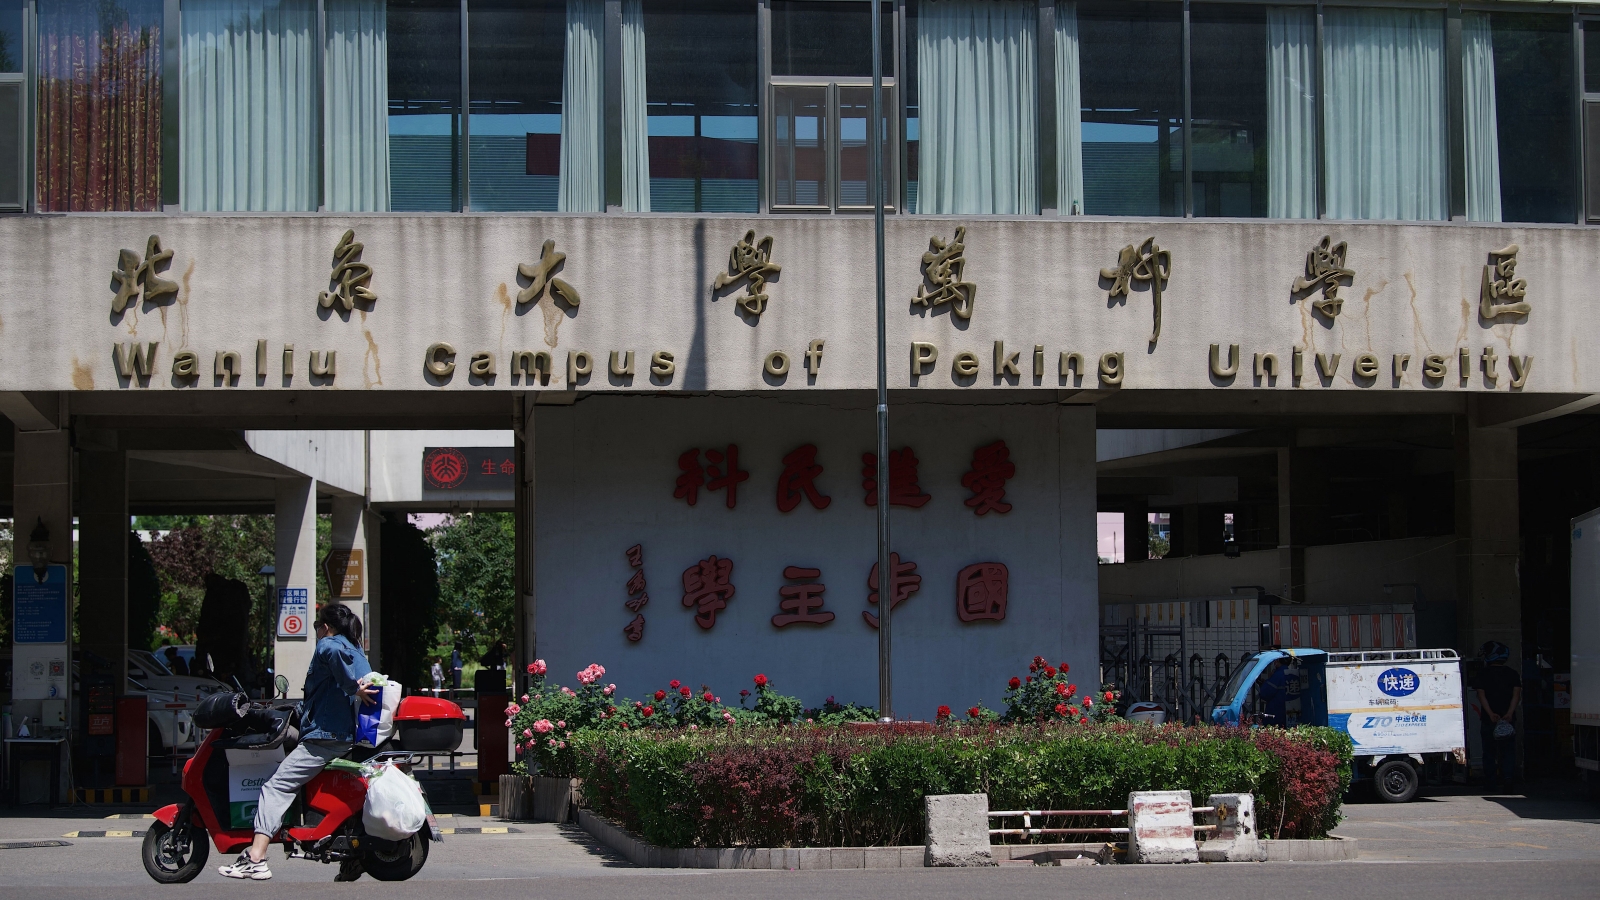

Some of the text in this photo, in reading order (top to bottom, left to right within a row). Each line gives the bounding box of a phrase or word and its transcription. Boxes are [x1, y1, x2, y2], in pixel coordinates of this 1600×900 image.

[113, 338, 1533, 387] Wanliu Campus of Peking University
[481, 458, 515, 476] 生命
[289, 619, 297, 629] 5
[1274, 621, 1281, 641] R
[1292, 621, 1299, 641] S
[1311, 622, 1318, 642] T
[1330, 621, 1338, 642] U
[1351, 621, 1359, 642] V
[1372, 622, 1380, 640] W
[1395, 620, 1403, 642] X
[1382, 674, 1415, 692] 快递
[1361, 716, 1394, 729] ZTO
[1395, 715, 1427, 723] 中通快递
